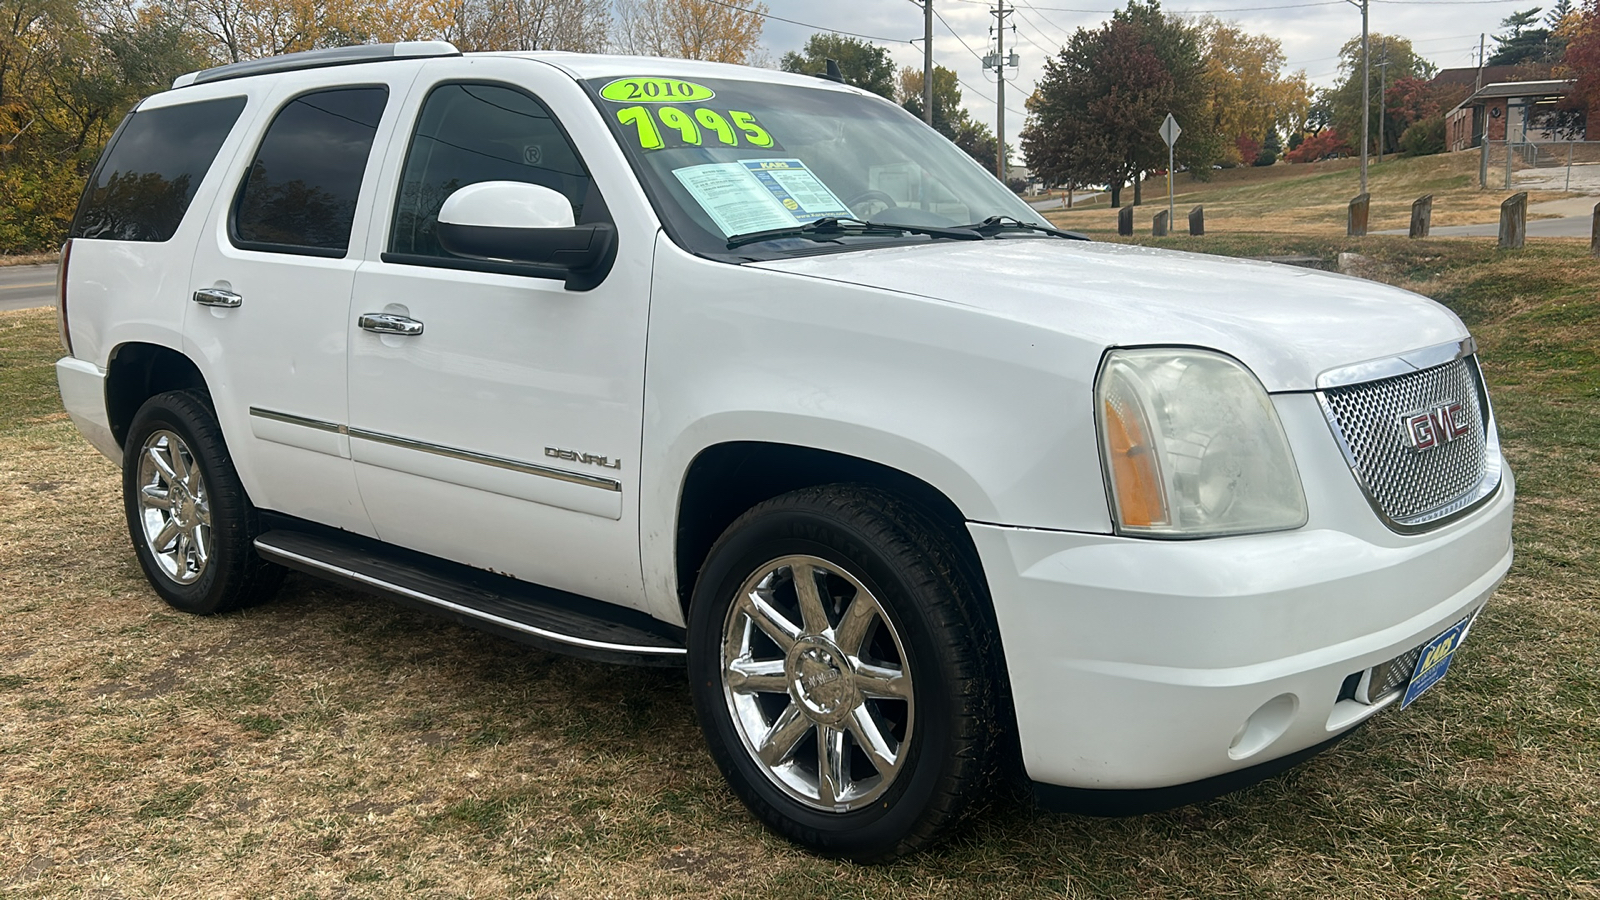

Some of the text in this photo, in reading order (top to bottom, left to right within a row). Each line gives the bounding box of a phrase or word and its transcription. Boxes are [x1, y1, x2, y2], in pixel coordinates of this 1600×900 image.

[624, 82, 694, 99] 2010
[617, 105, 775, 150] 7995
[760, 161, 789, 169] KARS
[1402, 402, 1469, 450] GMC
[543, 445, 622, 470] DENALI
